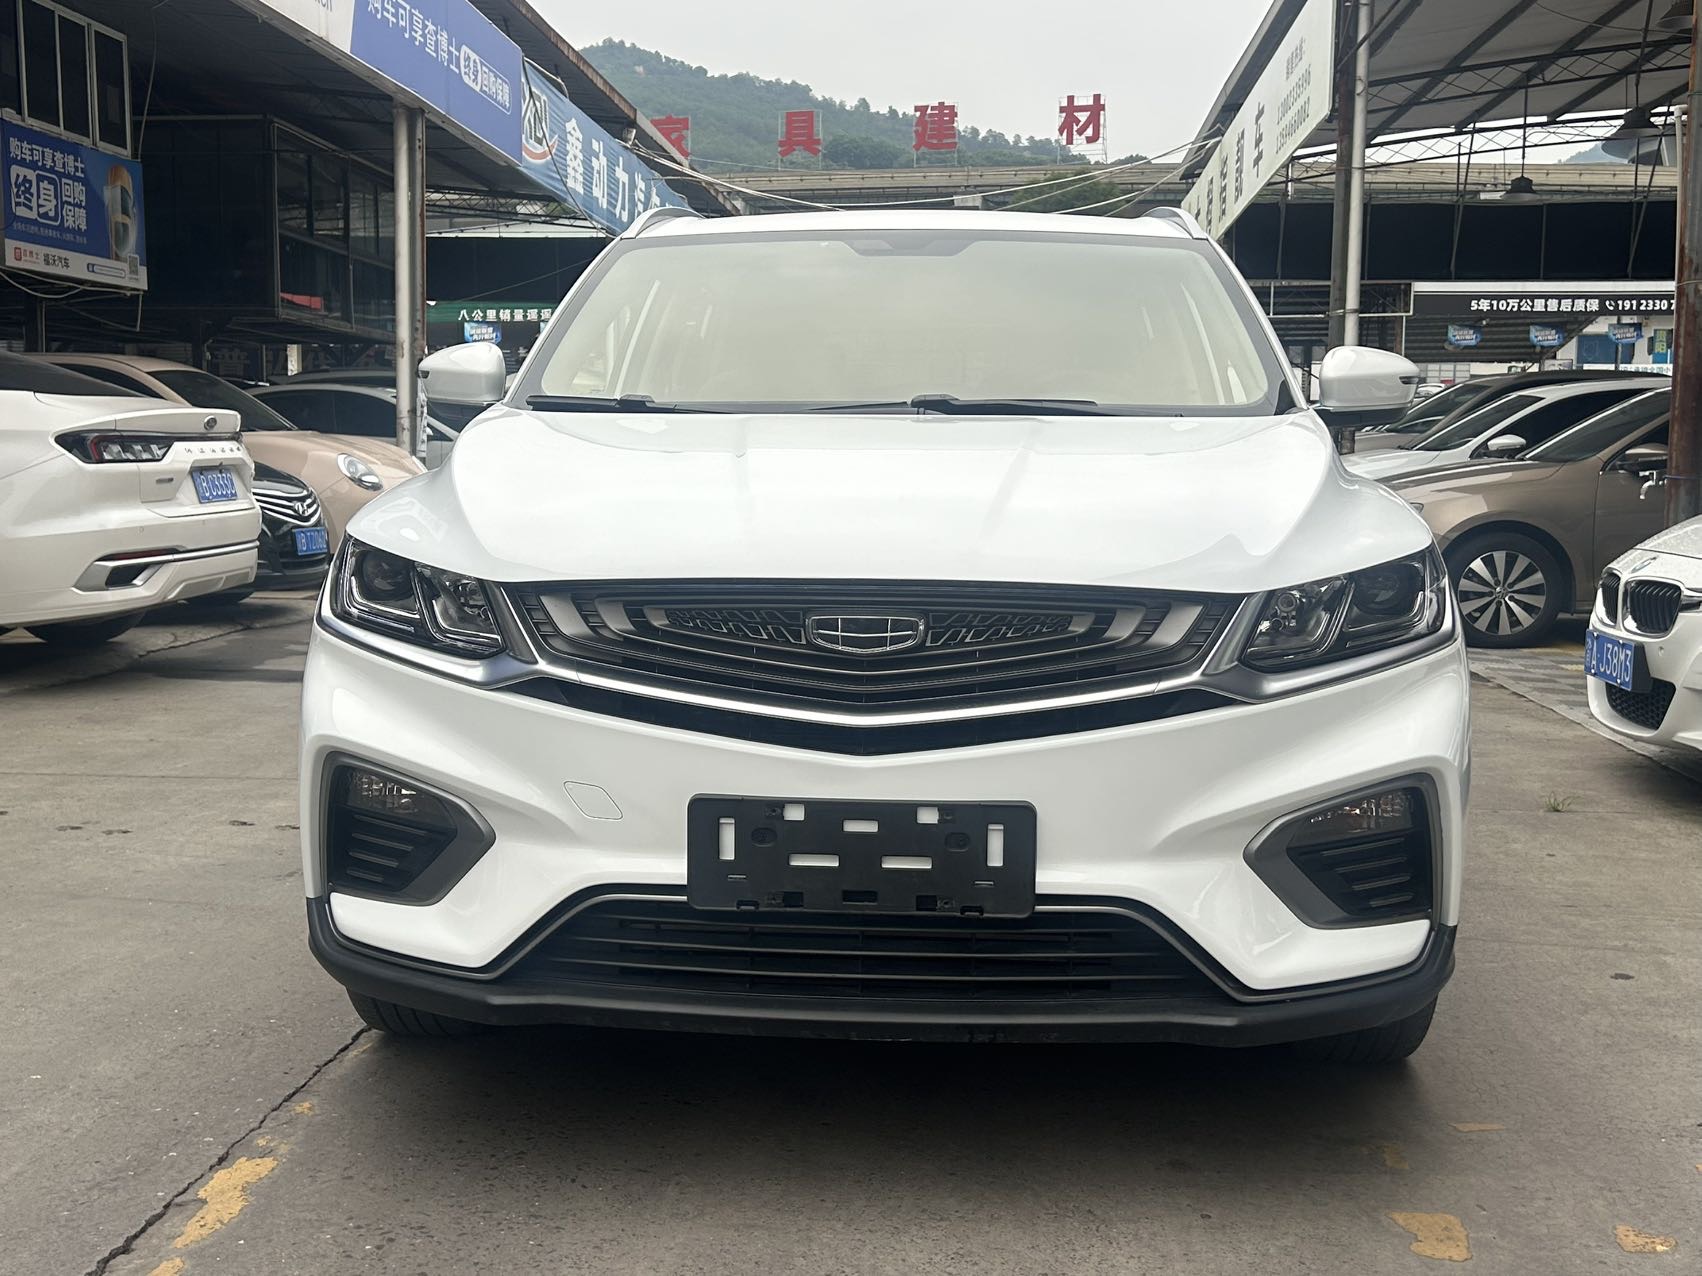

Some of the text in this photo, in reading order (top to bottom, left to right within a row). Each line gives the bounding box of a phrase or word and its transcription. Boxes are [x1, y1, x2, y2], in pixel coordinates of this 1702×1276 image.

[650, 93, 1106, 158] 家具建材
[10, 137, 85, 178] 购车可享查博士
[13, 174, 57, 217] 终身
[62, 178, 86, 206] 回购
[63, 204, 87, 232] 保障
[1470, 298, 1599, 312] 5年10万公里售后质保
[1617, 299, 1637, 310] 191
[1640, 299, 1668, 310] 2330
